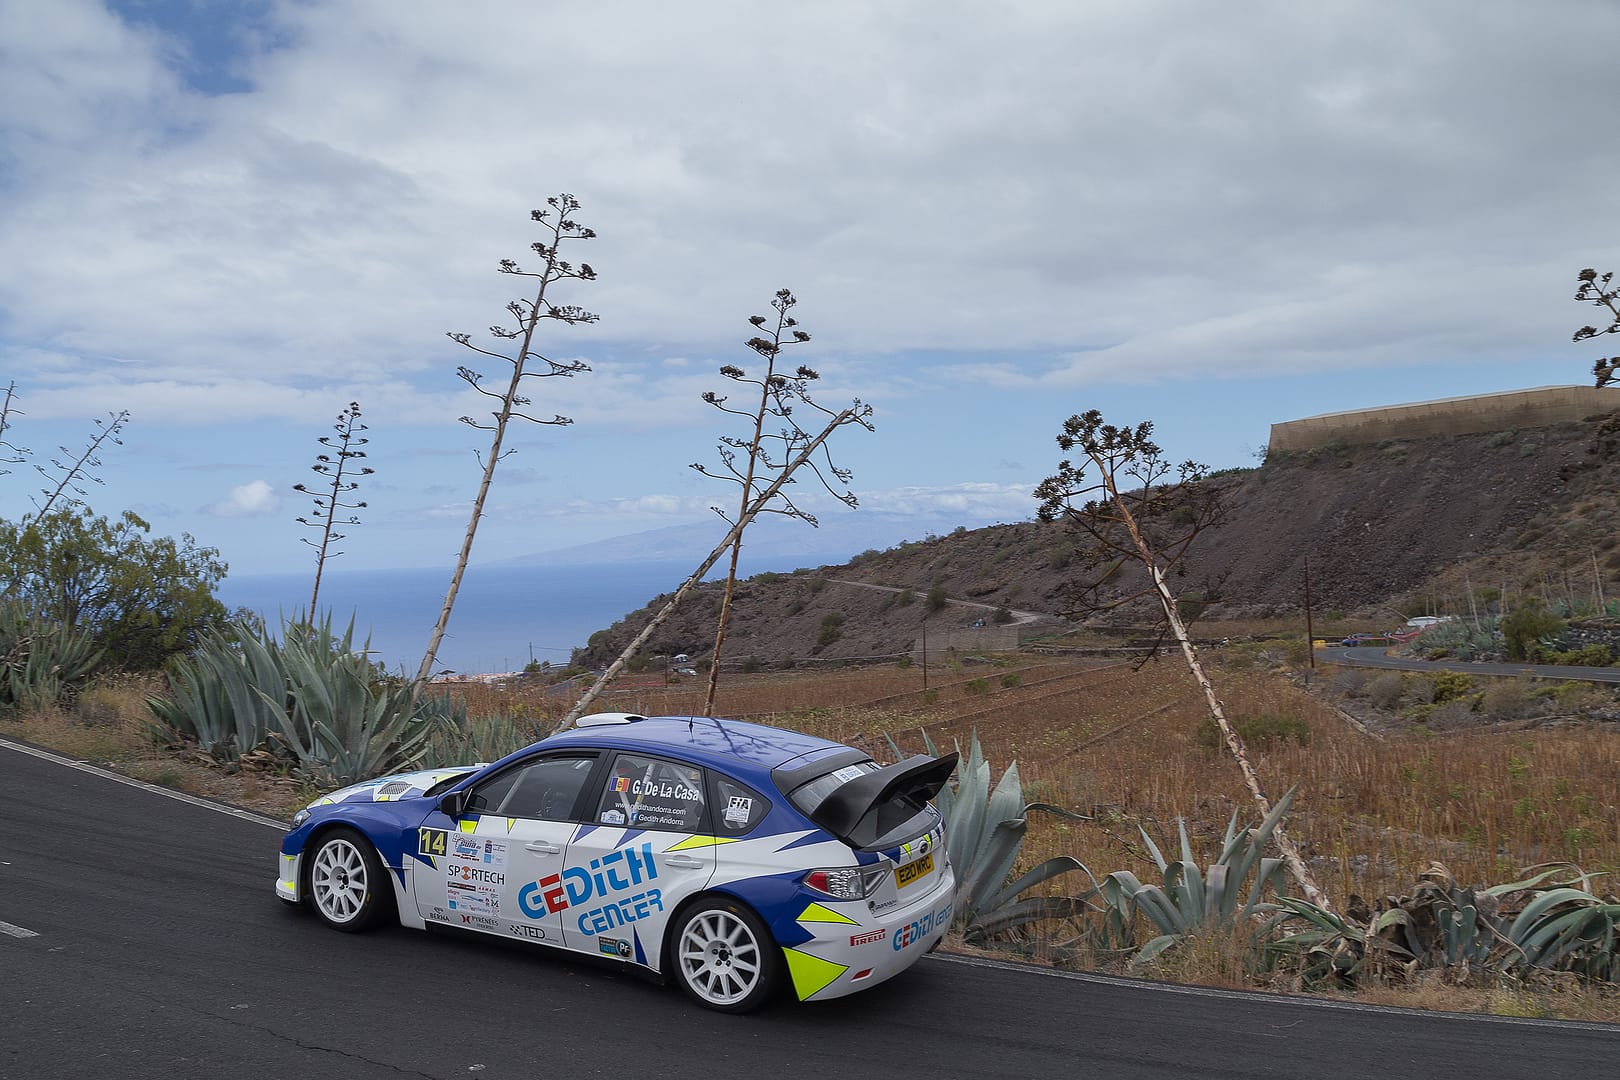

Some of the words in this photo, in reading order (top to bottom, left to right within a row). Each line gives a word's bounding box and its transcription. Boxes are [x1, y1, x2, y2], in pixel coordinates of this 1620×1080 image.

[632, 780, 642, 794] G.
[645, 781, 658, 797] De
[660, 783, 673, 798] La
[674, 784, 700, 801] Casa
[638, 814, 659, 824] Gedith
[659, 816, 684, 826] Andorra
[421, 830, 445, 854] 14
[448, 865, 505, 885] SPORTECH
[900, 864, 916, 883] E20
[917, 856, 931, 875] WRC
[850, 928, 886, 947] PIRELLI
